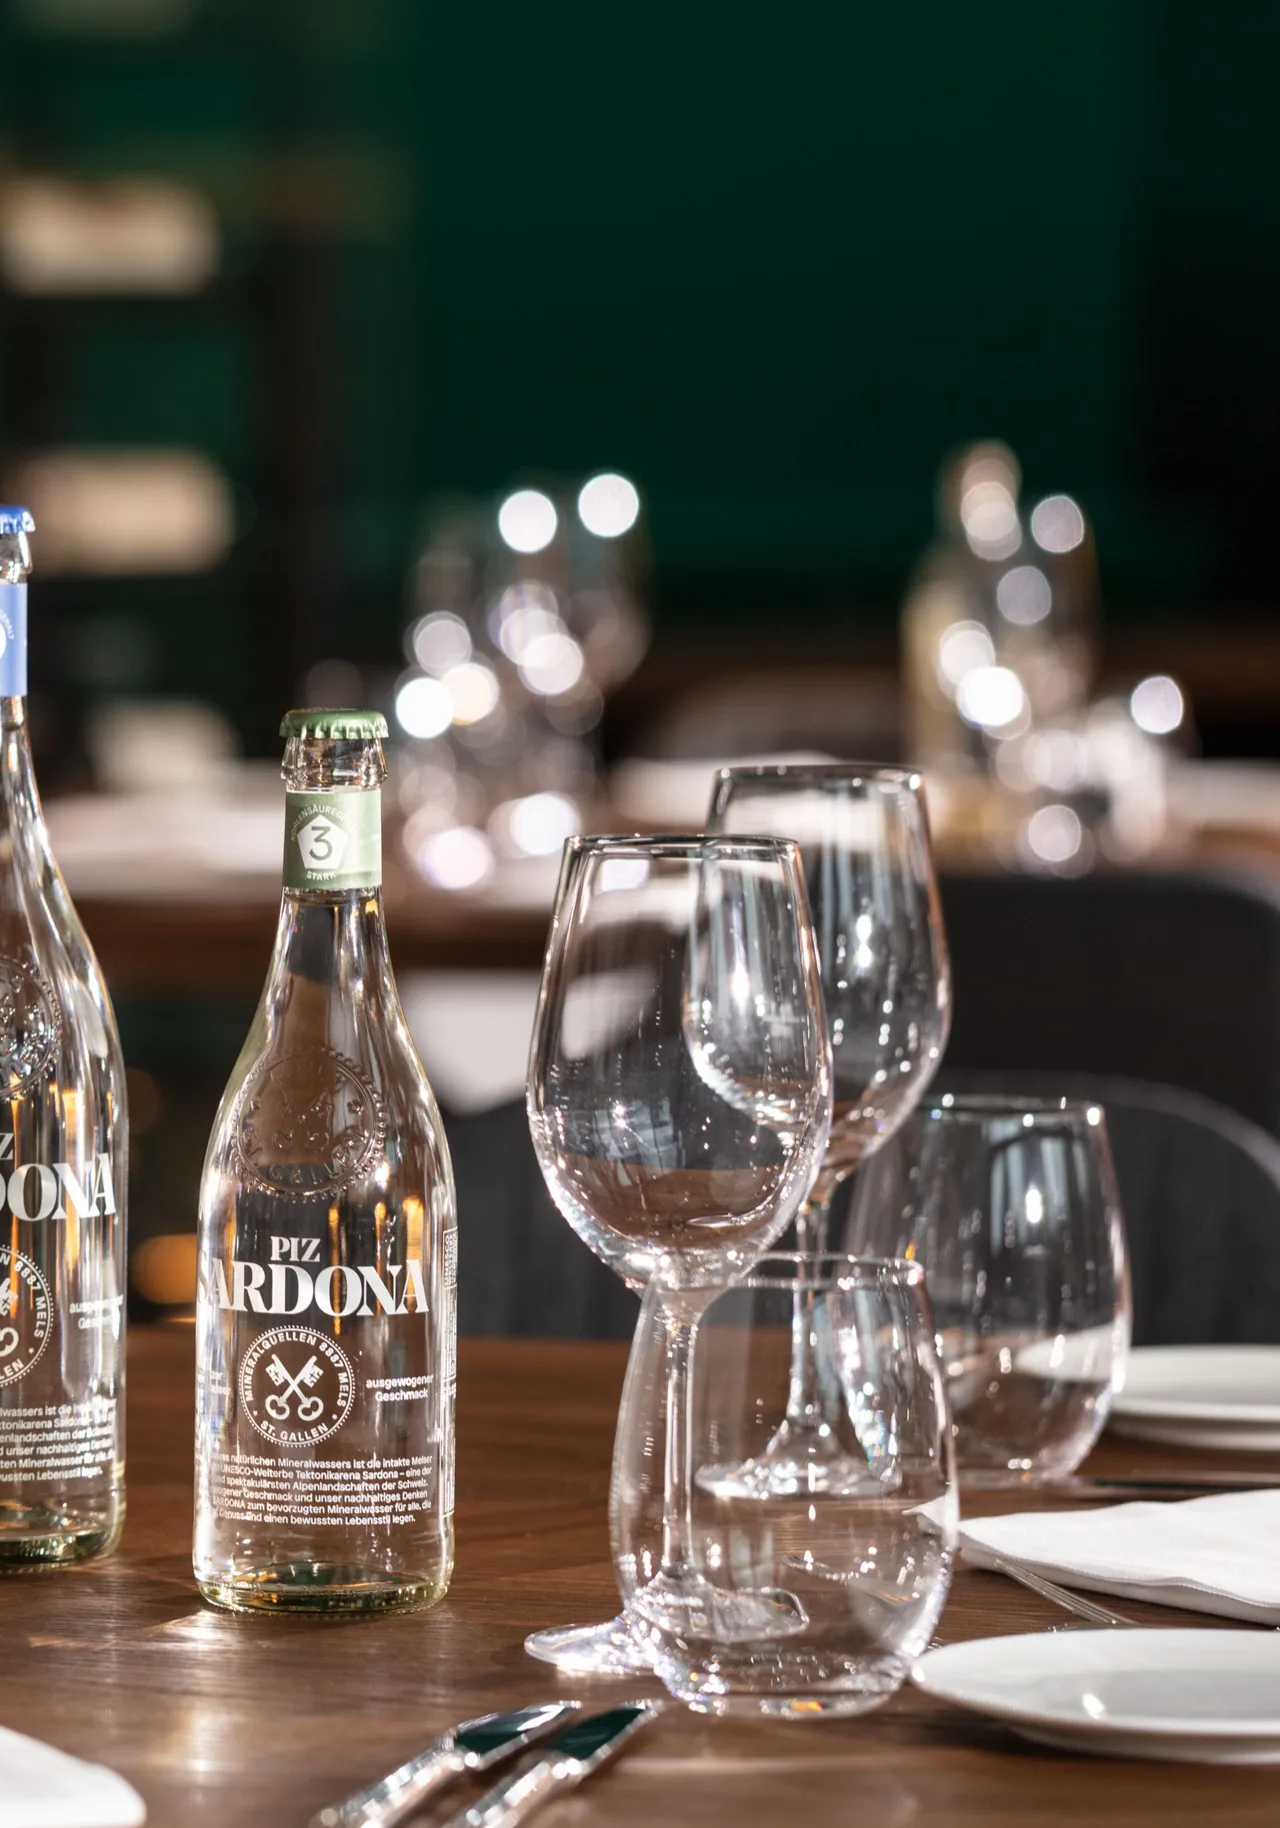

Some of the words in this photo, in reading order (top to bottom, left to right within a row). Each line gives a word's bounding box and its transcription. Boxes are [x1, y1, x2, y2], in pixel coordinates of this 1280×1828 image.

[309, 826, 332, 860] 3
[306, 871, 336, 881] STARK
[270, 1236, 321, 1262] PIZ
[13, 1261, 42, 1291] 8887
[34, 1297, 46, 1338] MELS
[245, 1332, 317, 1402] MINERALQUELLEN
[319, 1342, 344, 1368] 8887
[336, 1372, 347, 1407] MELS
[366, 1375, 433, 1389] ausgewogener
[375, 1388, 428, 1401] Geschmack
[45, 1406, 56, 1416] ist
[260, 1421, 276, 1436] ST.
[280, 1422, 329, 1442] GALLEN
[6, 1446, 33, 1456] unser
[18, 1456, 84, 1468] Mineralwasser
[231, 1454, 275, 1466] natürlichen
[278, 1457, 351, 1469] Mineralwassers
[353, 1459, 365, 1468] ist
[367, 1458, 381, 1468] die
[383, 1457, 410, 1468] intakte
[412, 1455, 433, 1465] Melser
[37, 1468, 81, 1480] Lebensstil
[296, 1470, 360, 1480] Tektonikarena
[362, 1469, 398, 1480] Sardona
[406, 1467, 421, 1477] eine
[422, 1466, 433, 1475] der
[227, 1476, 290, 1489] spektakulärsten
[292, 1480, 380, 1492] Alpenlandschaften
[382, 1481, 396, 1490] der
[398, 1478, 428, 1490] Schweiz.
[244, 1489, 293, 1501] Geschmack
[295, 1493, 312, 1502] und
[315, 1493, 341, 1503] unser
[344, 1492, 400, 1504] nachhaltiges
[402, 1490, 428, 1500] Denken
[247, 1501, 264, 1510] zum
[267, 1503, 325, 1515] bevorzugten
[327, 1504, 393, 1515] Mineralwasser
[395, 1502, 406, 1512] für
[408, 1501, 421, 1512] alle,
[422, 1500, 432, 1510] die
[264, 1513, 288, 1523] einen
[291, 1515, 343, 1526] bewussten
[345, 1515, 390, 1526] Lebensstil
[393, 1515, 415, 1526] legen.
